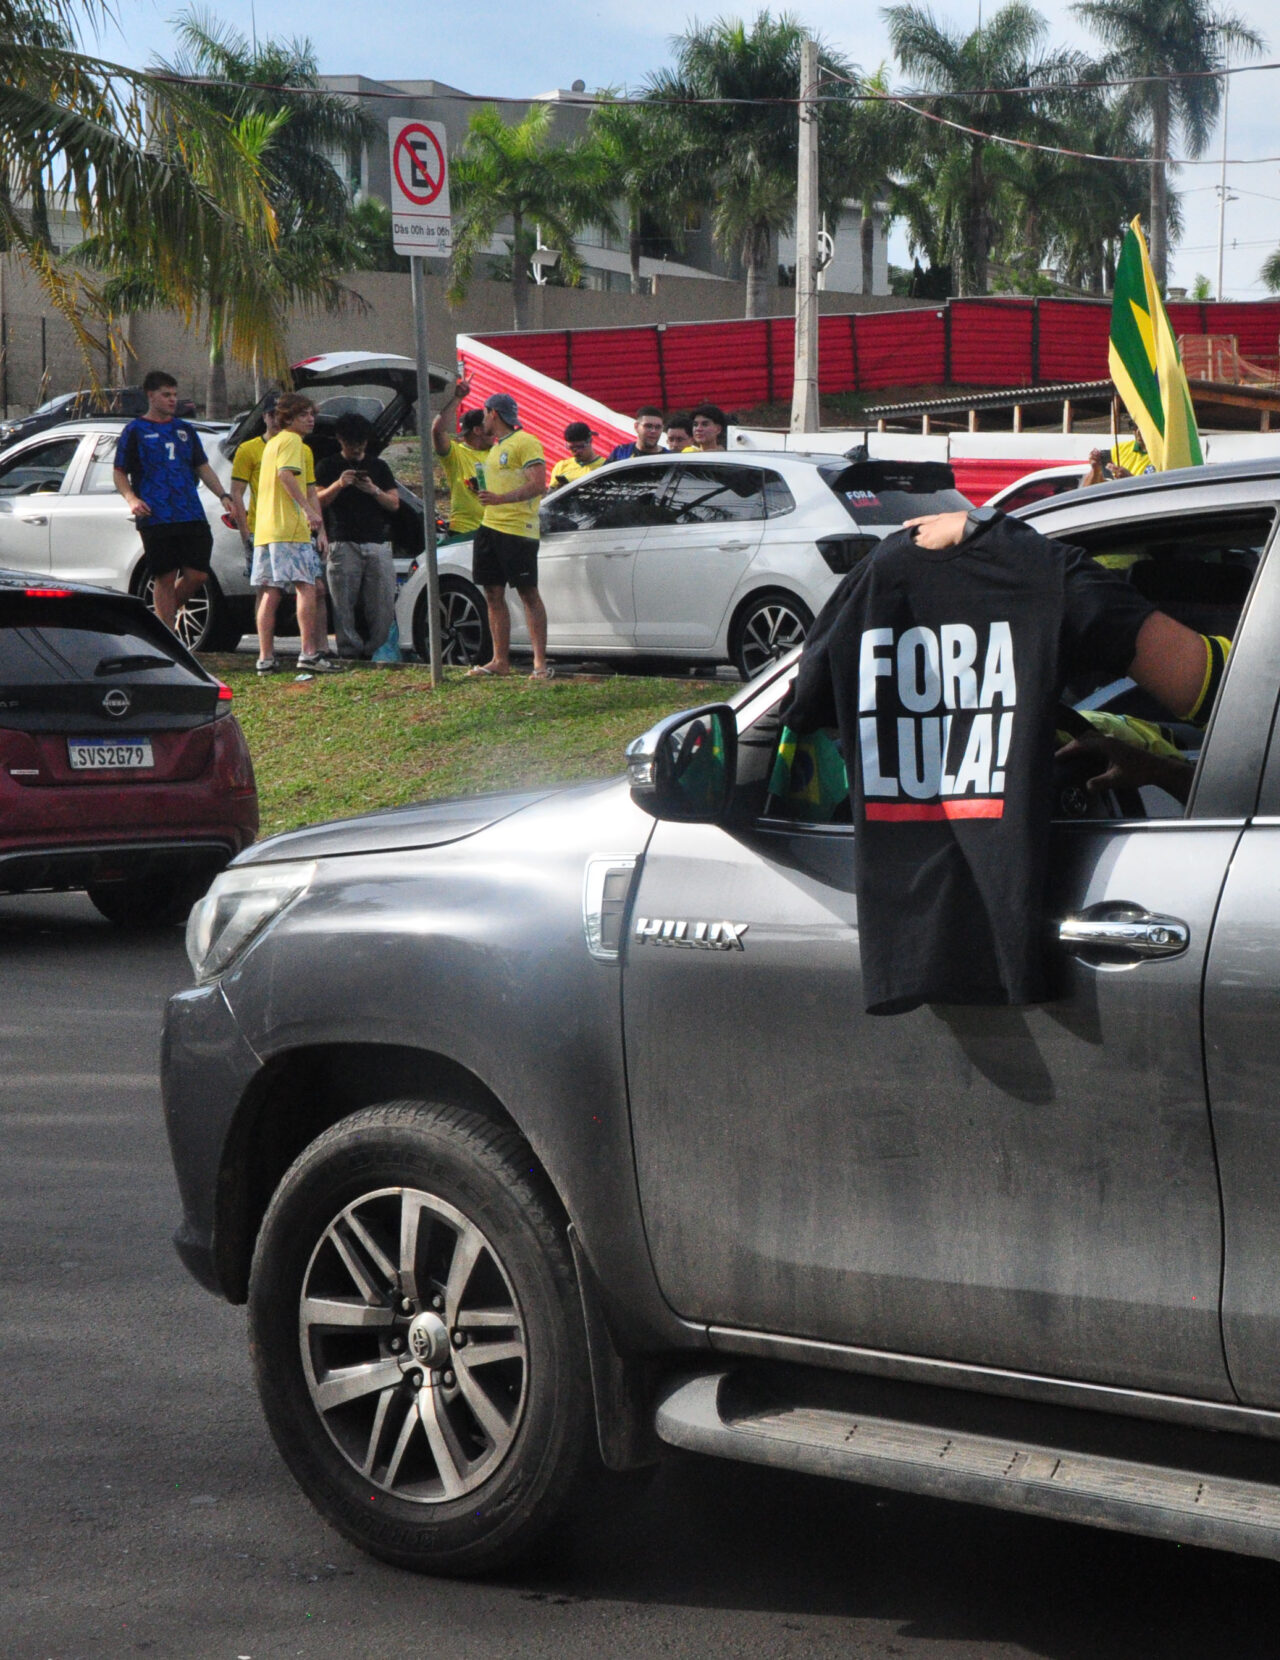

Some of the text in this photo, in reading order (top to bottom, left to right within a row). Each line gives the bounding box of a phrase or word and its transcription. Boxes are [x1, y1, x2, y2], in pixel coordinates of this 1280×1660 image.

[165, 442, 175, 460] 7
[845, 490, 876, 500] FORA
[858, 621, 1017, 713] FORA
[77, 747, 145, 766] SVS2G79
[858, 711, 1014, 799] LULA!
[635, 918, 749, 951] HILUX
